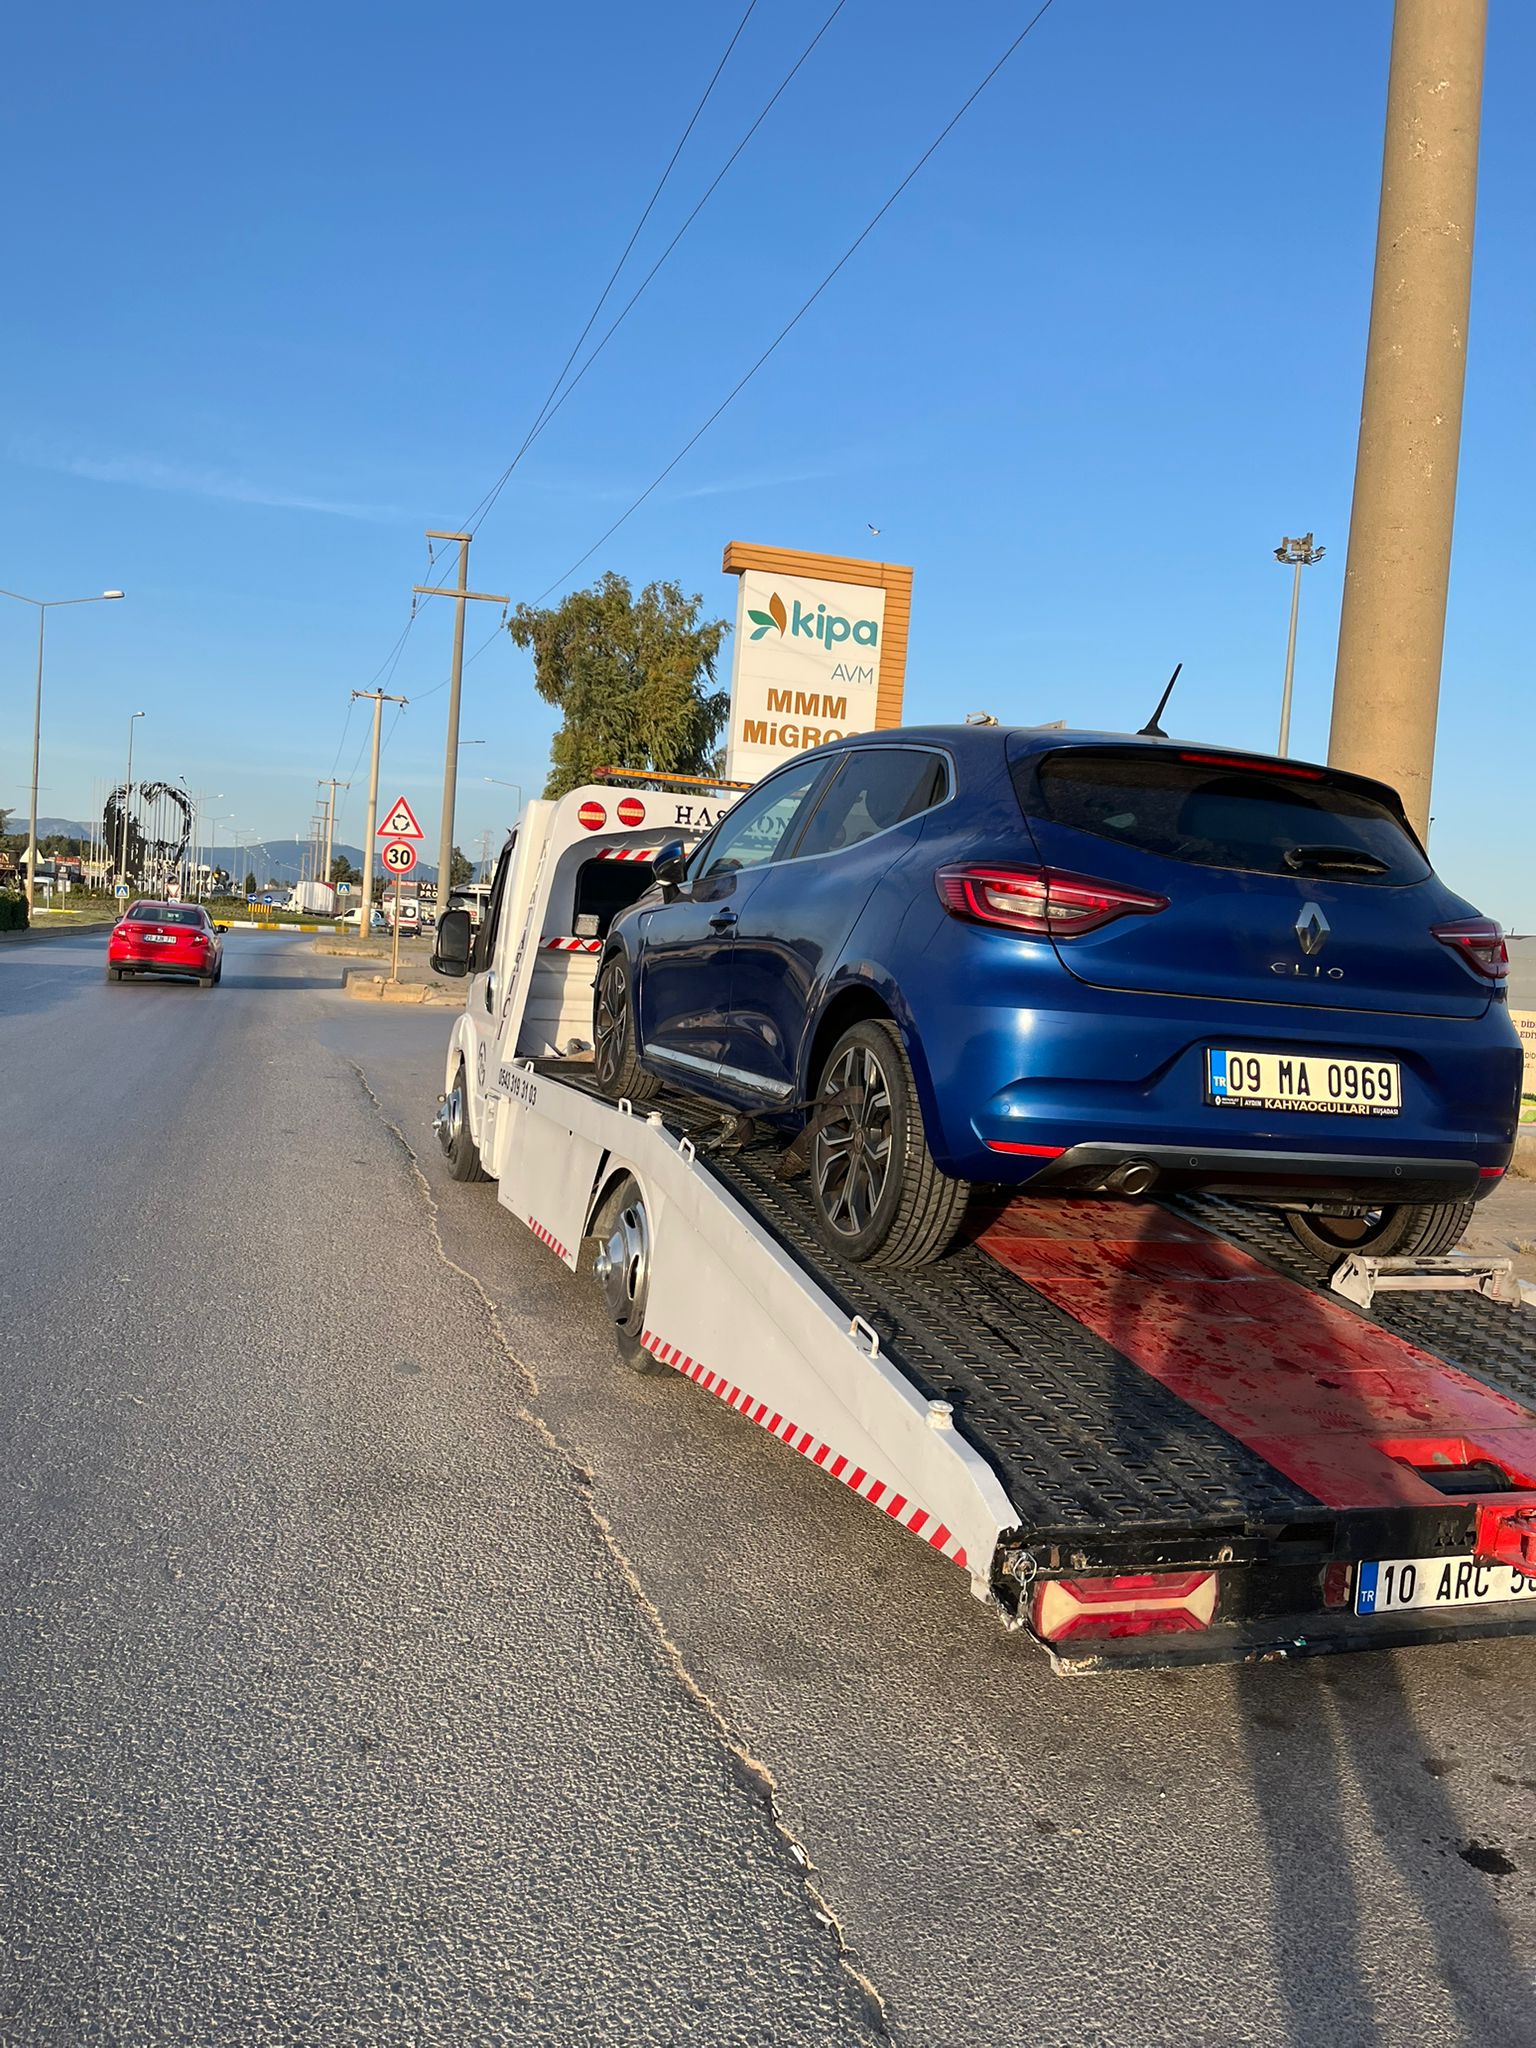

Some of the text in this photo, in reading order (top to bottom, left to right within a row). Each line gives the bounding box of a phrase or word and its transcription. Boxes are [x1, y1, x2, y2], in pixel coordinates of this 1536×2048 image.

[791, 600, 879, 651] kipa
[831, 663, 874, 685] AVM
[767, 688, 847, 720] MMM
[388, 848, 411, 866] 30
[420, 883, 438, 891] YAL
[420, 890, 439, 898] PRO
[1270, 961, 1345, 980] CLIO
[1213, 1056, 1392, 1101] TR 09 MA 0969
[521, 1080, 529, 1100] 31
[528, 1084, 537, 1106] 03
[1361, 1590, 1374, 1603] TR
[1384, 1564, 1417, 1605] 10
[1436, 1561, 1491, 1601] ARC
